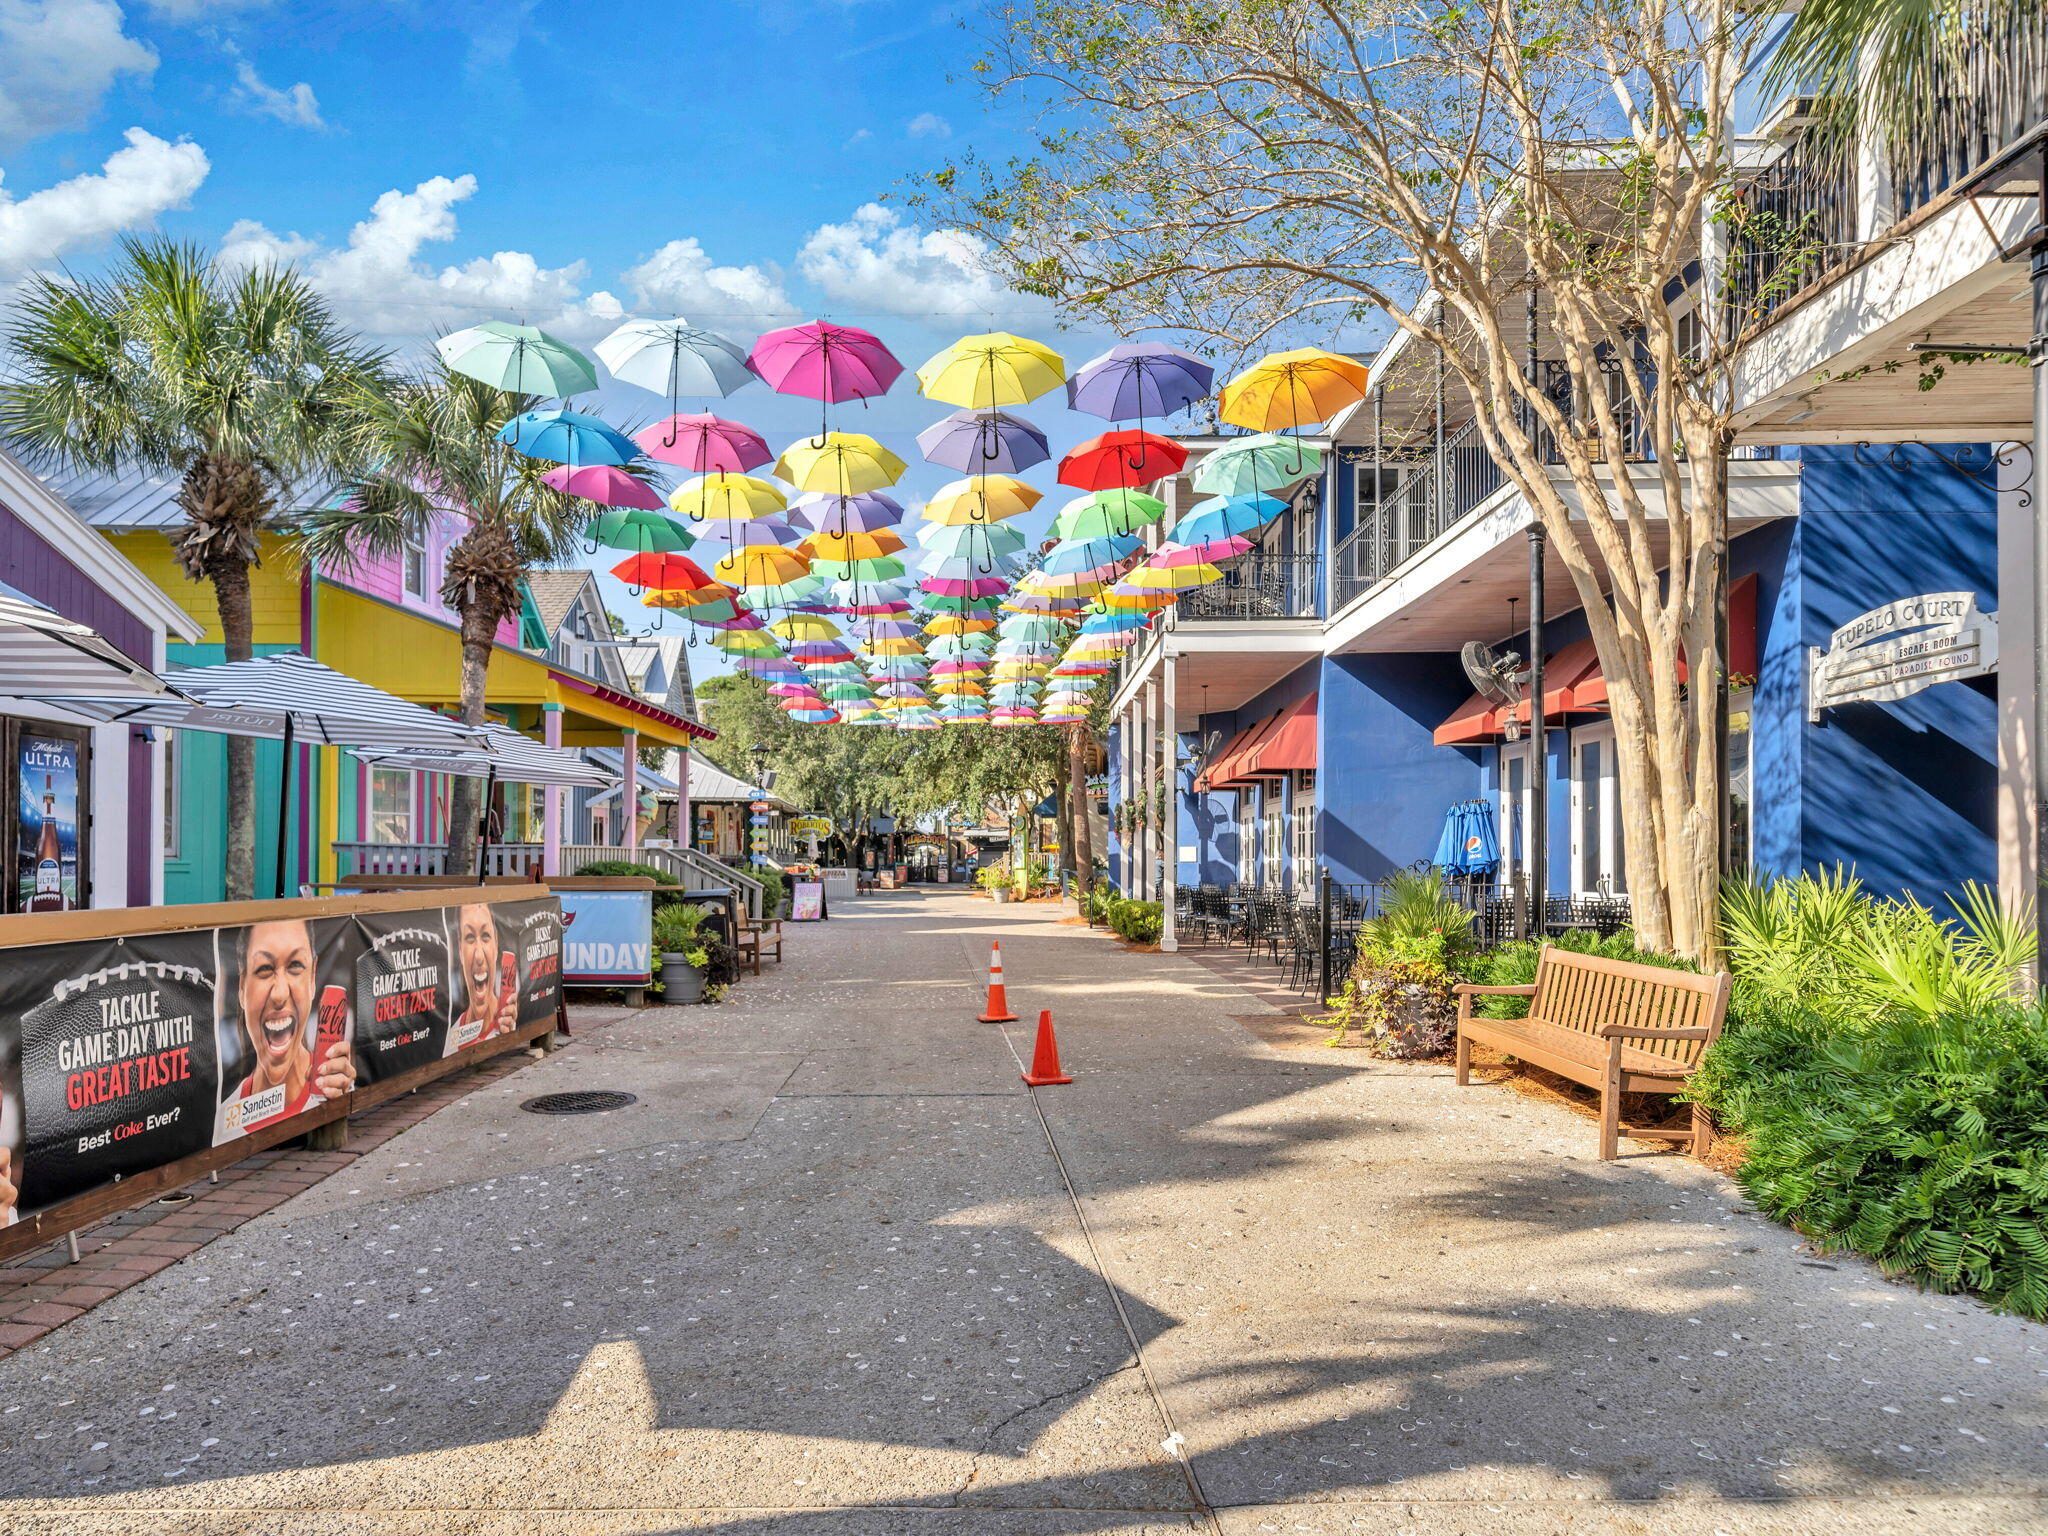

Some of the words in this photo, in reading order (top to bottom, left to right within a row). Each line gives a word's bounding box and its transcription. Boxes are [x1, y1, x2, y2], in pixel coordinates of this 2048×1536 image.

[1836, 610, 1896, 649] TUPELO
[1902, 600, 1965, 621] COURT
[1899, 643, 1929, 657] ESCAPE
[1933, 635, 1958, 650] ROOM
[1894, 660, 1933, 676] PARADISE
[1939, 653, 1969, 667] FOUND
[25, 752, 71, 768] ULTRA
[391, 948, 421, 971] TACKLE
[562, 942, 647, 970] UNDAY
[373, 973, 400, 997] GAME
[401, 970, 417, 992] DAY
[417, 965, 438, 988] WITH
[99, 991, 160, 1028] TACKLE
[375, 993, 410, 1023] GREAT
[410, 987, 437, 1015] TASTE
[58, 1031, 113, 1072] GAME
[118, 1023, 151, 1058] DAY
[153, 1015, 193, 1049] WITH
[380, 1037, 397, 1052] Best
[397, 1033, 413, 1046] Coke
[412, 1027, 430, 1042] Ever?
[67, 1060, 133, 1111] GREAT
[135, 1047, 191, 1091] TASTE
[242, 1089, 282, 1115] Sandestin
[77, 1129, 111, 1153] Best
[113, 1121, 144, 1141] Coke
[146, 1107, 181, 1131] Ever?
